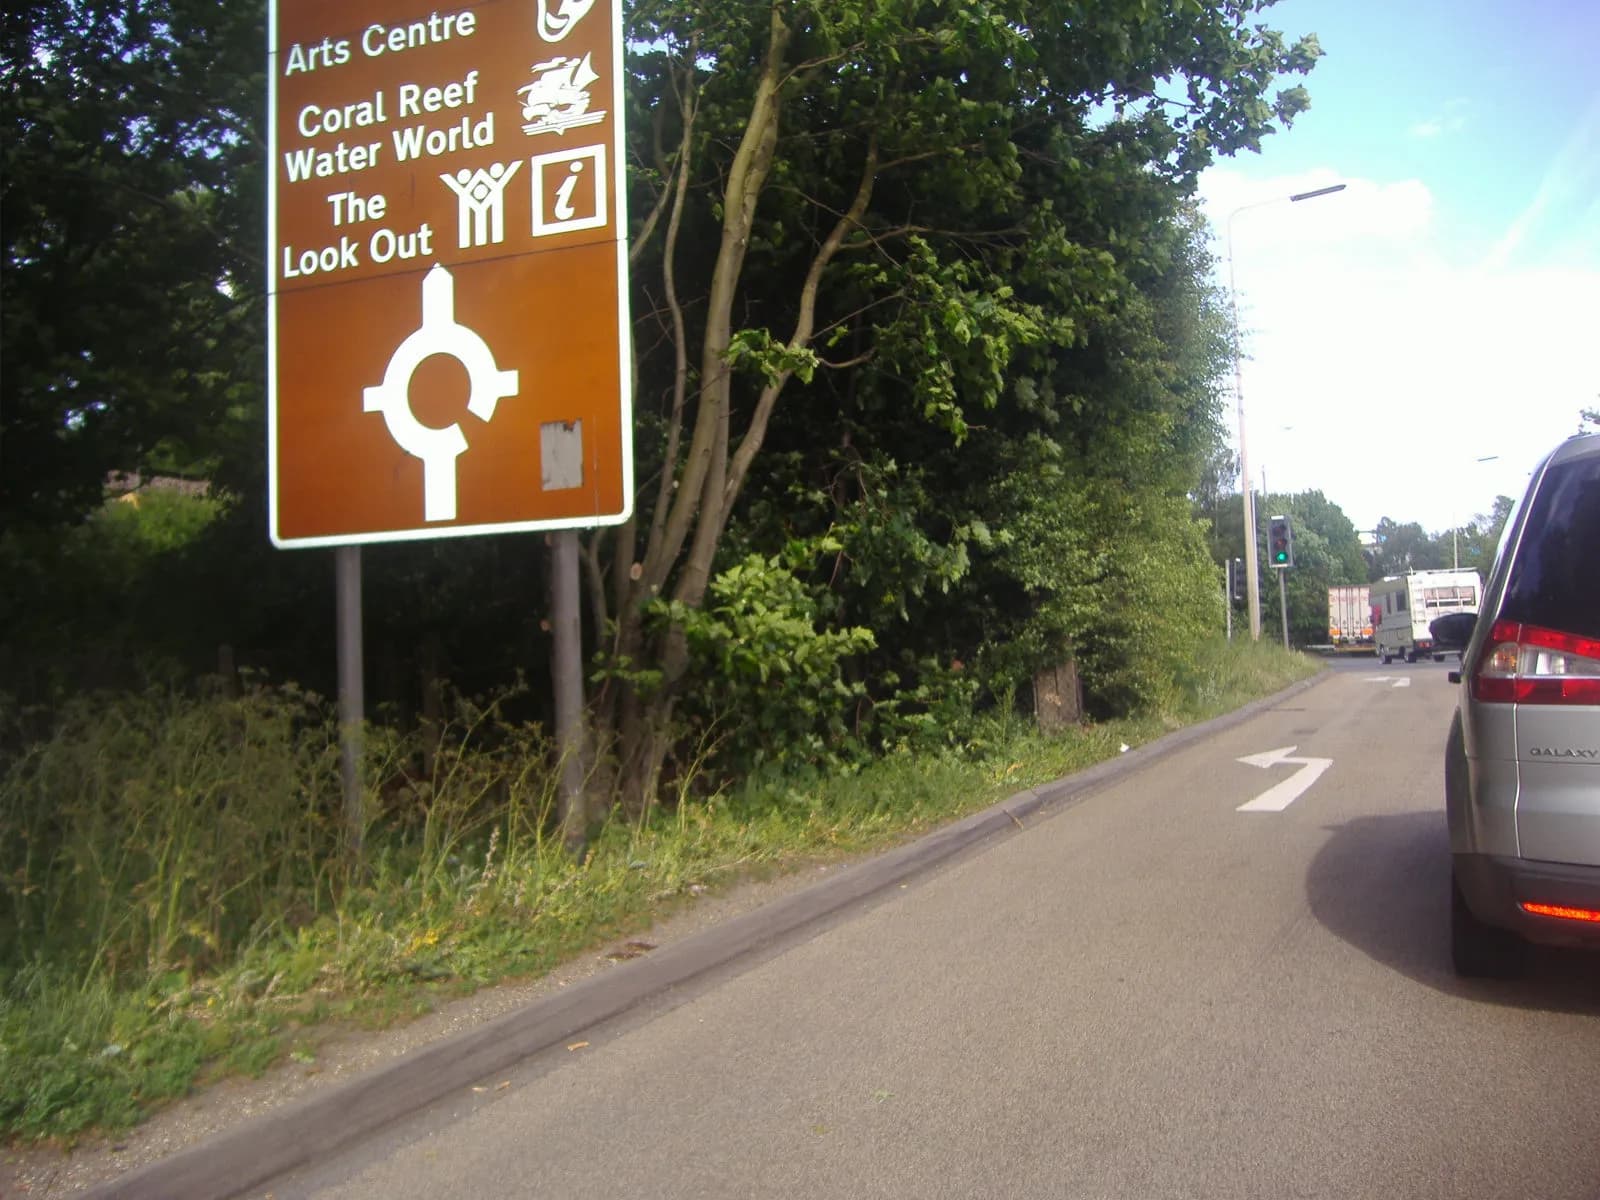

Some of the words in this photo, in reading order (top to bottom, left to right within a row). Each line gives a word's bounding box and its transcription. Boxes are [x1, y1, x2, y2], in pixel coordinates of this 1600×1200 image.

[285, 37, 350, 76] Arts
[362, 11, 476, 57] Centre
[299, 91, 386, 137] Coral
[399, 70, 479, 118] Reef
[285, 142, 382, 183] Water
[392, 112, 494, 162] World
[327, 192, 386, 226] The
[283, 236, 359, 278] Look
[370, 223, 433, 262] Out
[1530, 747, 1598, 758] GALAXY
